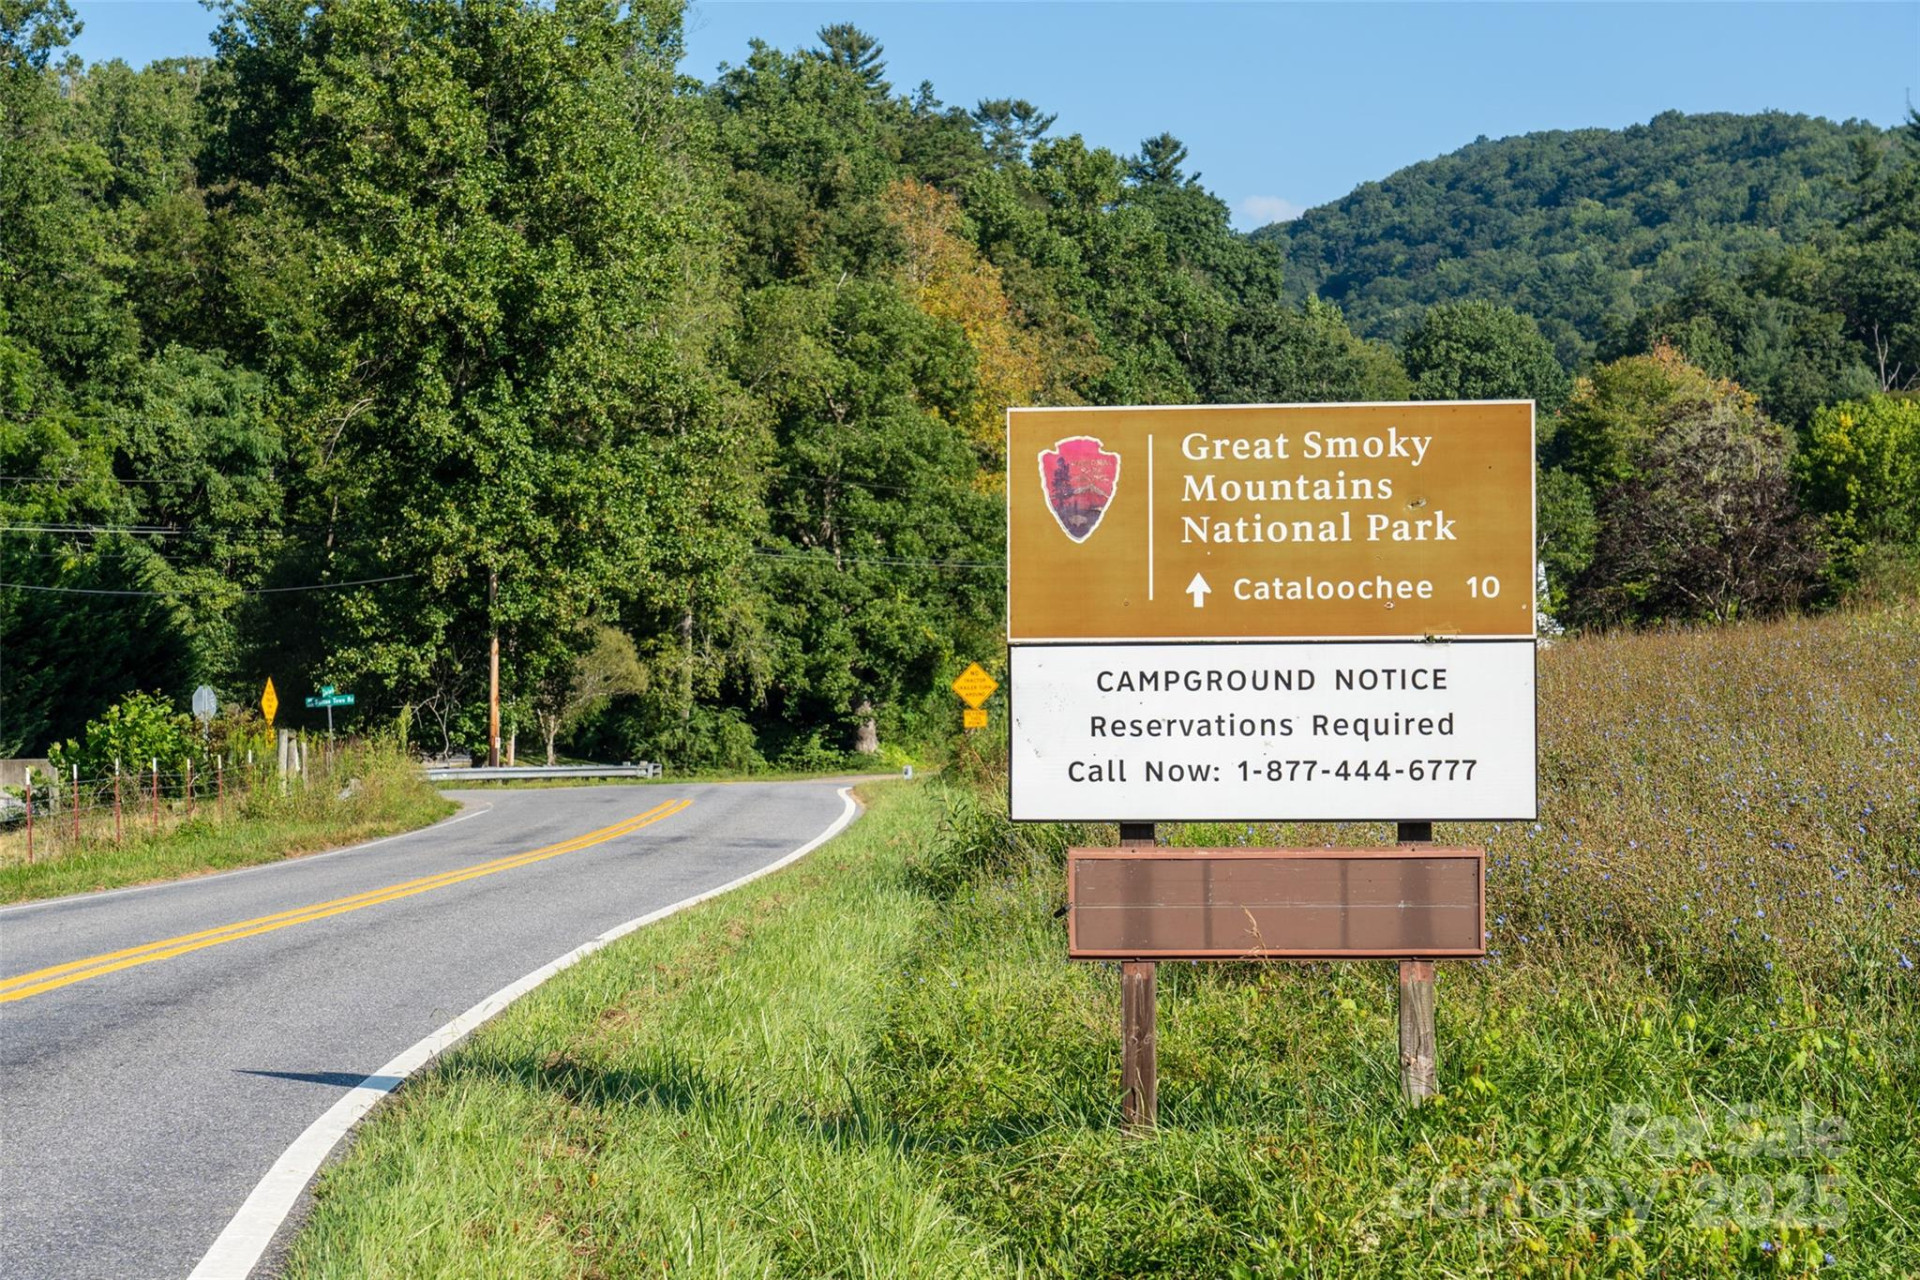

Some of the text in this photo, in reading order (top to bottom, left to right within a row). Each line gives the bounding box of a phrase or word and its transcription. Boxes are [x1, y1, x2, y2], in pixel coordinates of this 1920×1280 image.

[1181, 427, 1432, 467] Great Smoky
[1181, 471, 1393, 502] Mountains
[1181, 510, 1457, 543] National Park
[1233, 575, 1500, 601] Cataloochee 10
[1097, 668, 1447, 692] CAMPGROUND NOTICE
[1091, 712, 1453, 742] Reservations Required
[1068, 758, 1477, 783] Call Now: 1-877-444-6777
